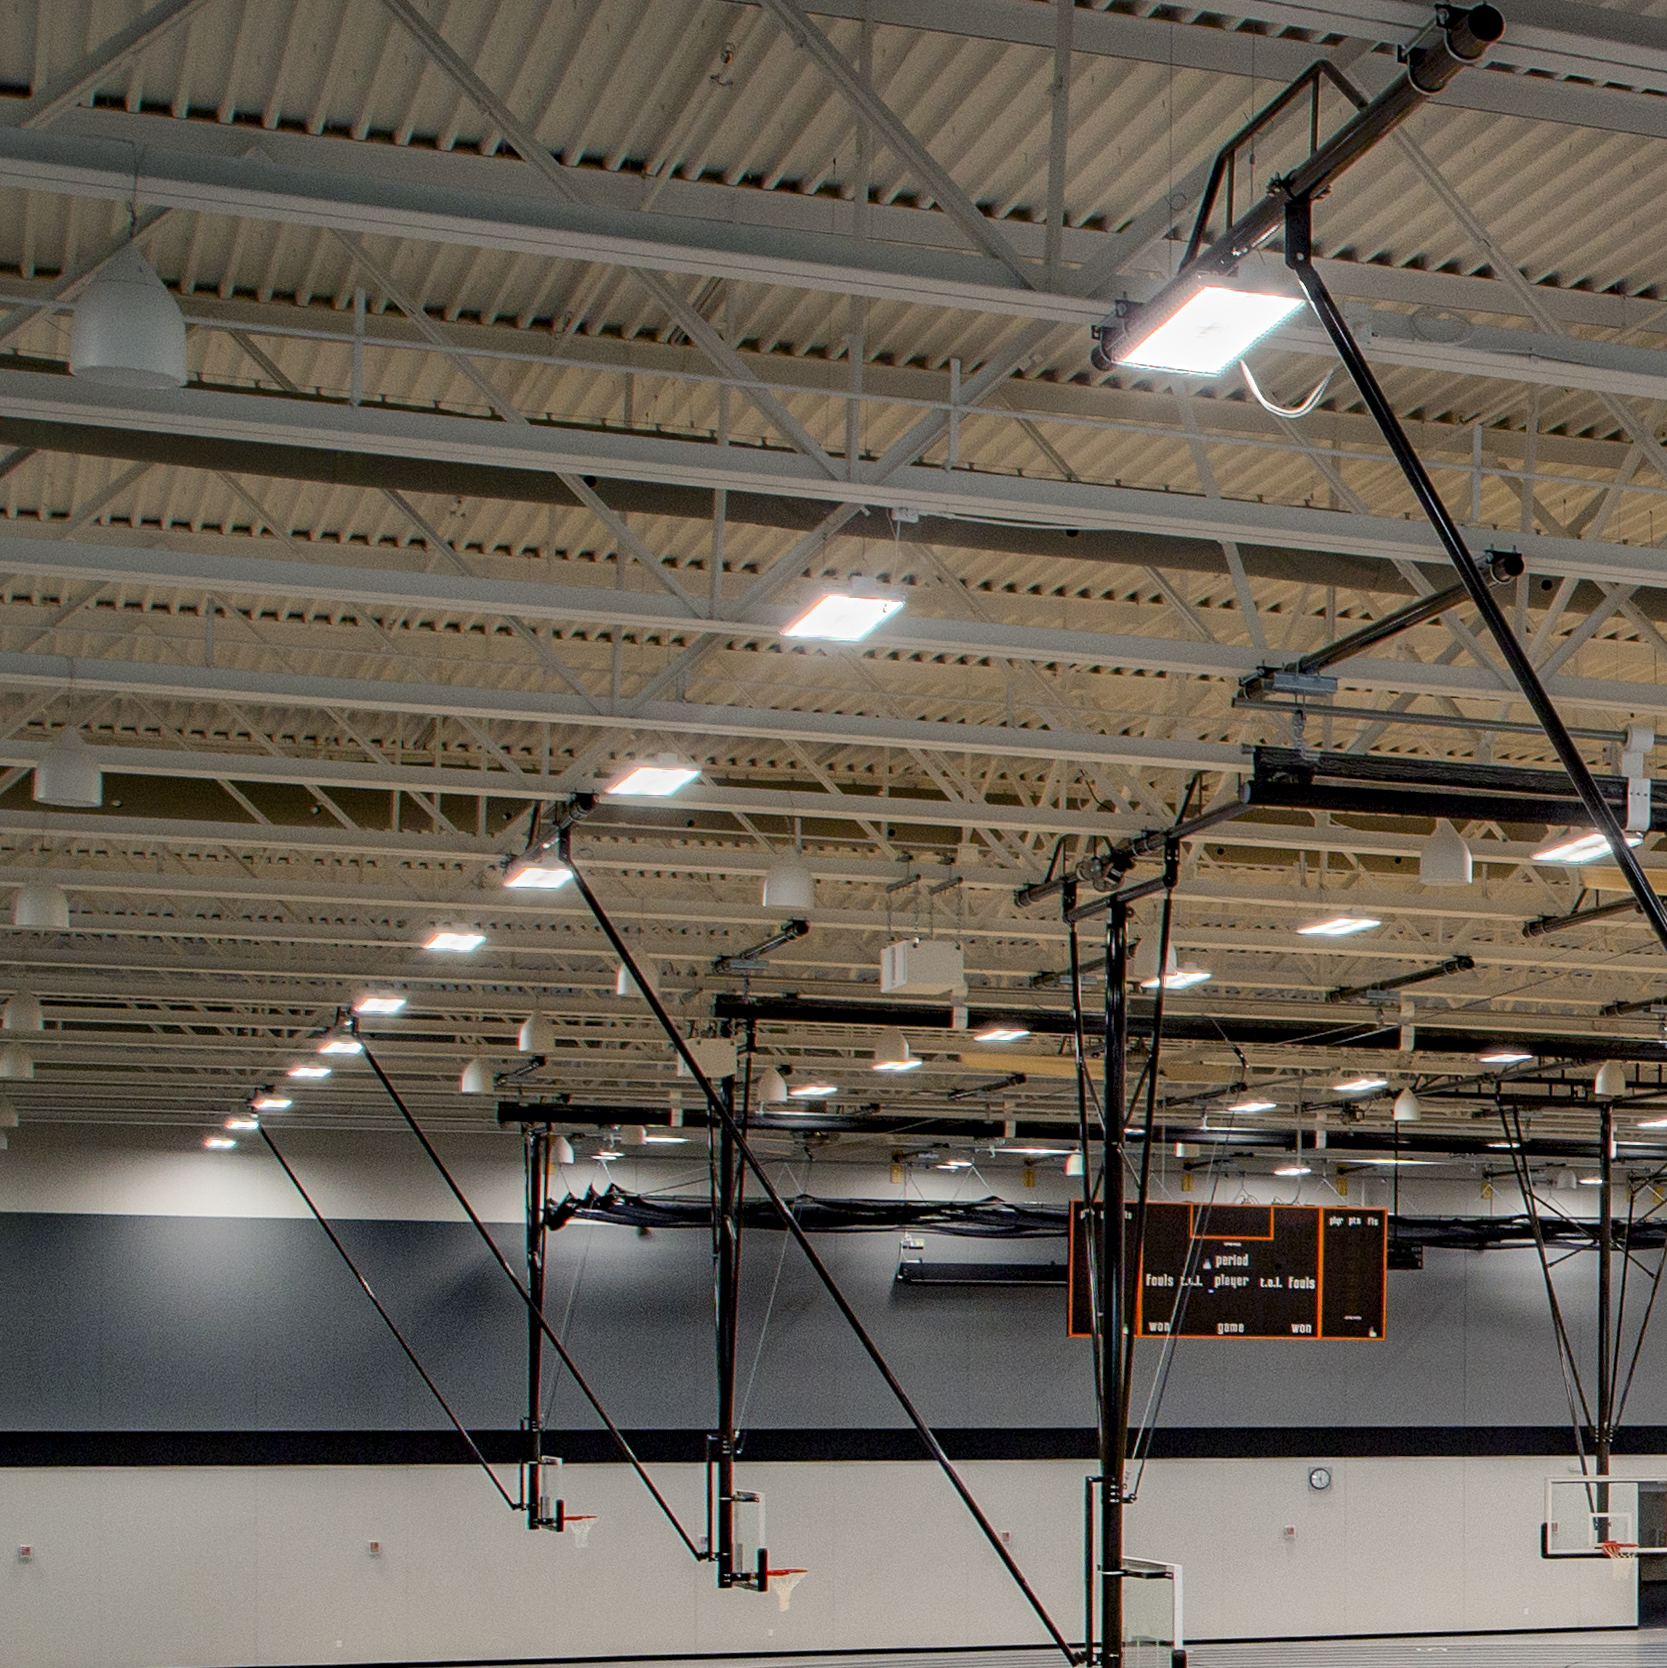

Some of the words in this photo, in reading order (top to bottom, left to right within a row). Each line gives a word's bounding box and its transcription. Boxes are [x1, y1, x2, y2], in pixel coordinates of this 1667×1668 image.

[1348, 1216, 1362, 1227] pts
[1214, 1254, 1249, 1268] period
[1213, 1273, 1250, 1289] player
[1260, 1277, 1283, 1289] t.o.l.
[1148, 1321, 1171, 1333] won
[1217, 1322, 1245, 1334] game
[1291, 1323, 1312, 1334] won
